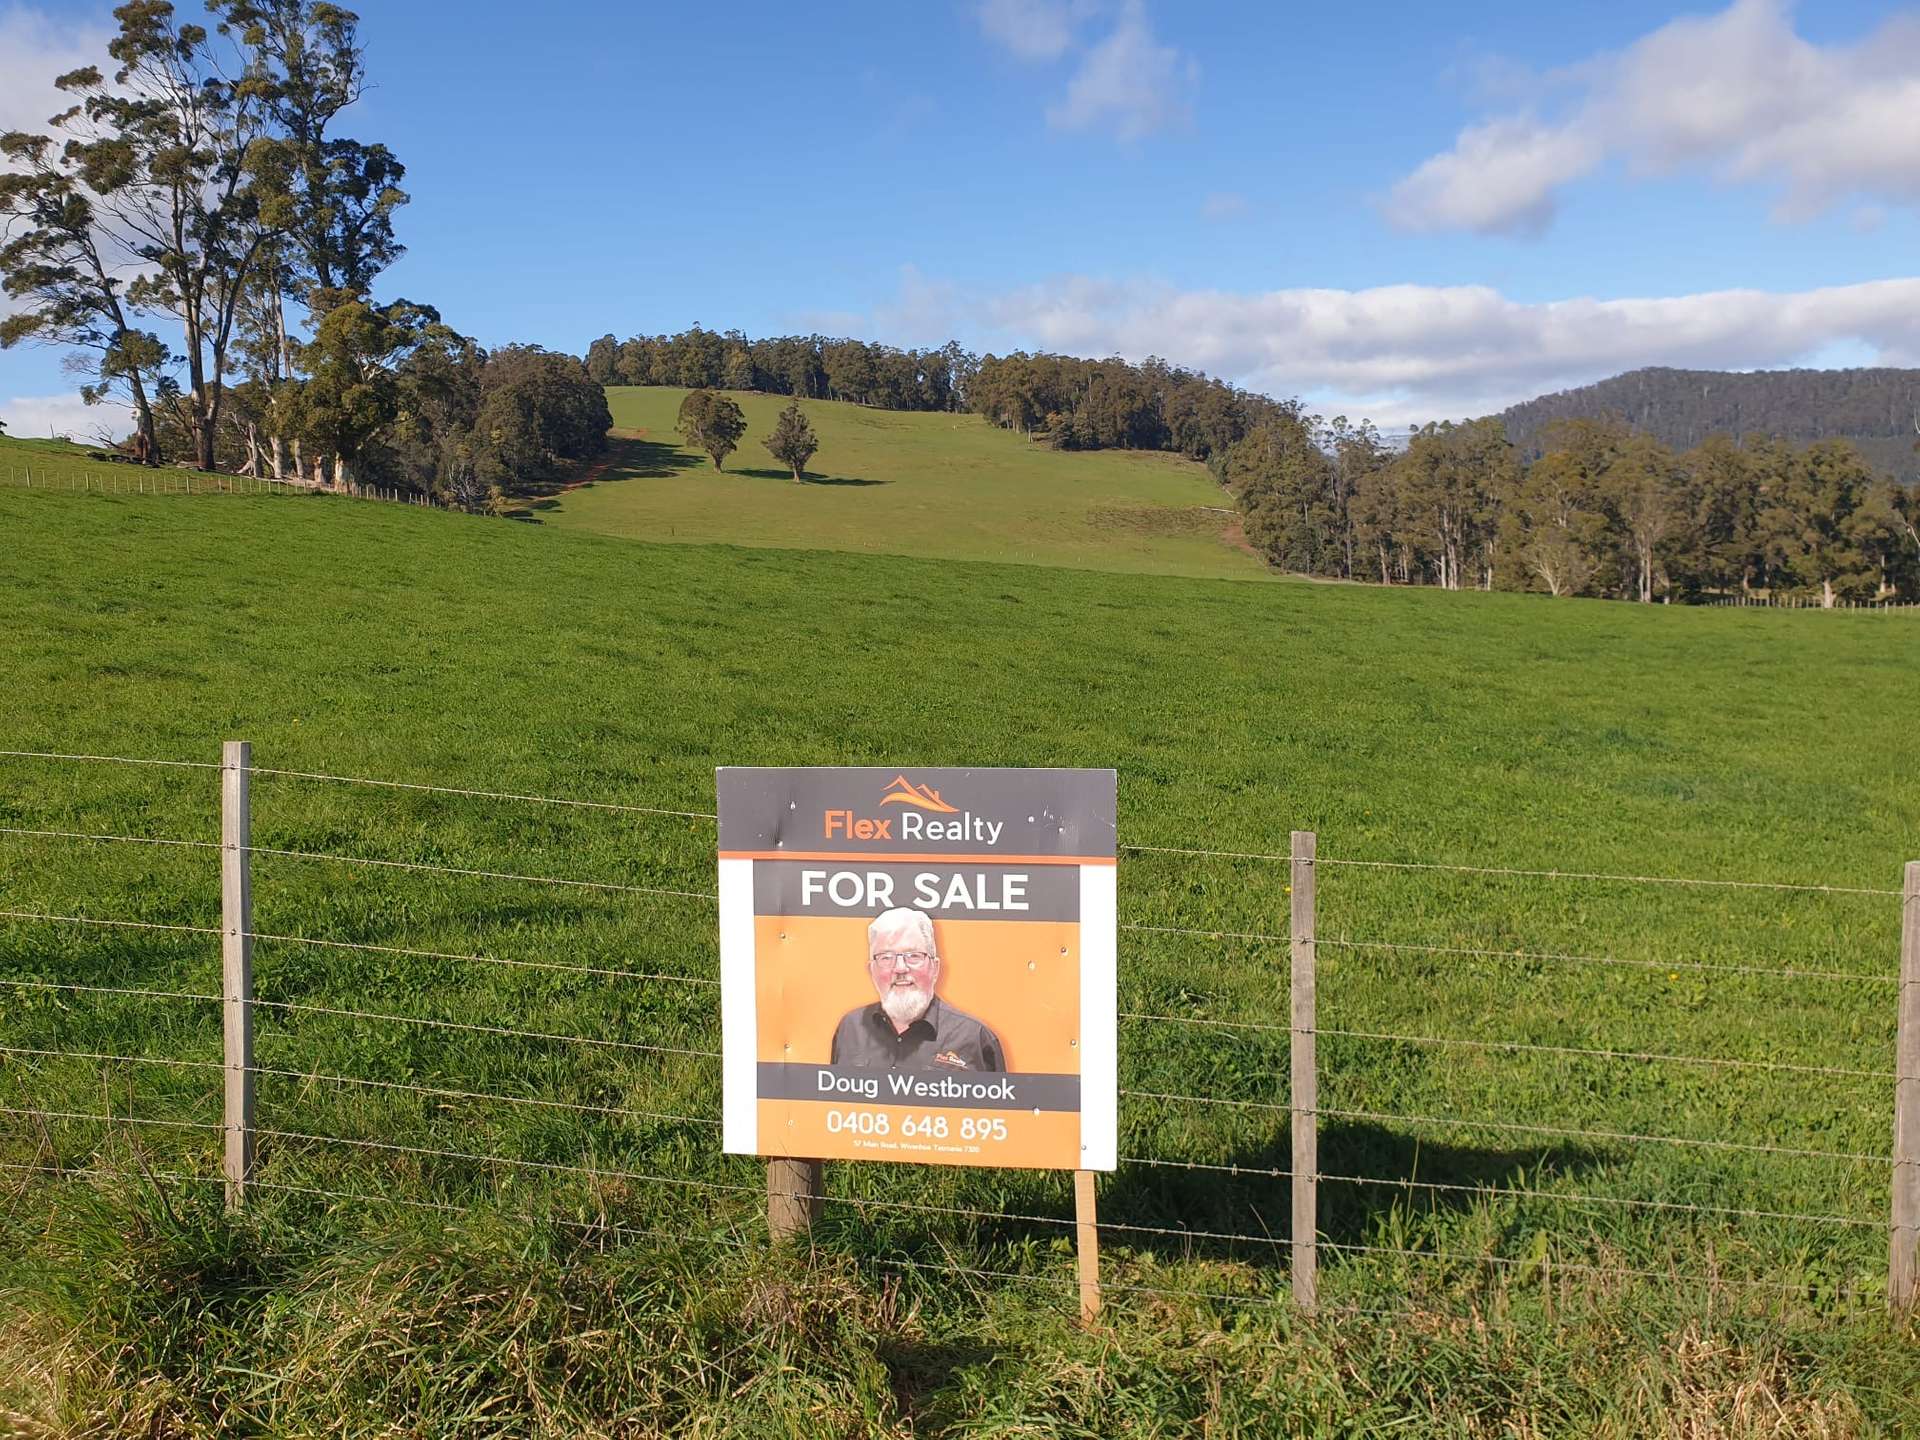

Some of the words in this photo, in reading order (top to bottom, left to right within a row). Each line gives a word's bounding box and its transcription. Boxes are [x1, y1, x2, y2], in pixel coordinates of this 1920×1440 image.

[824, 810, 892, 840] Flex
[902, 811, 1004, 845] Realty
[801, 870, 895, 908] FOR
[912, 872, 1030, 911] SALE
[817, 1070, 879, 1099] Doug
[887, 1074, 1016, 1101] Westbrook
[826, 1110, 890, 1136] 0408
[901, 1114, 949, 1138] 648
[960, 1117, 1008, 1141] 895
